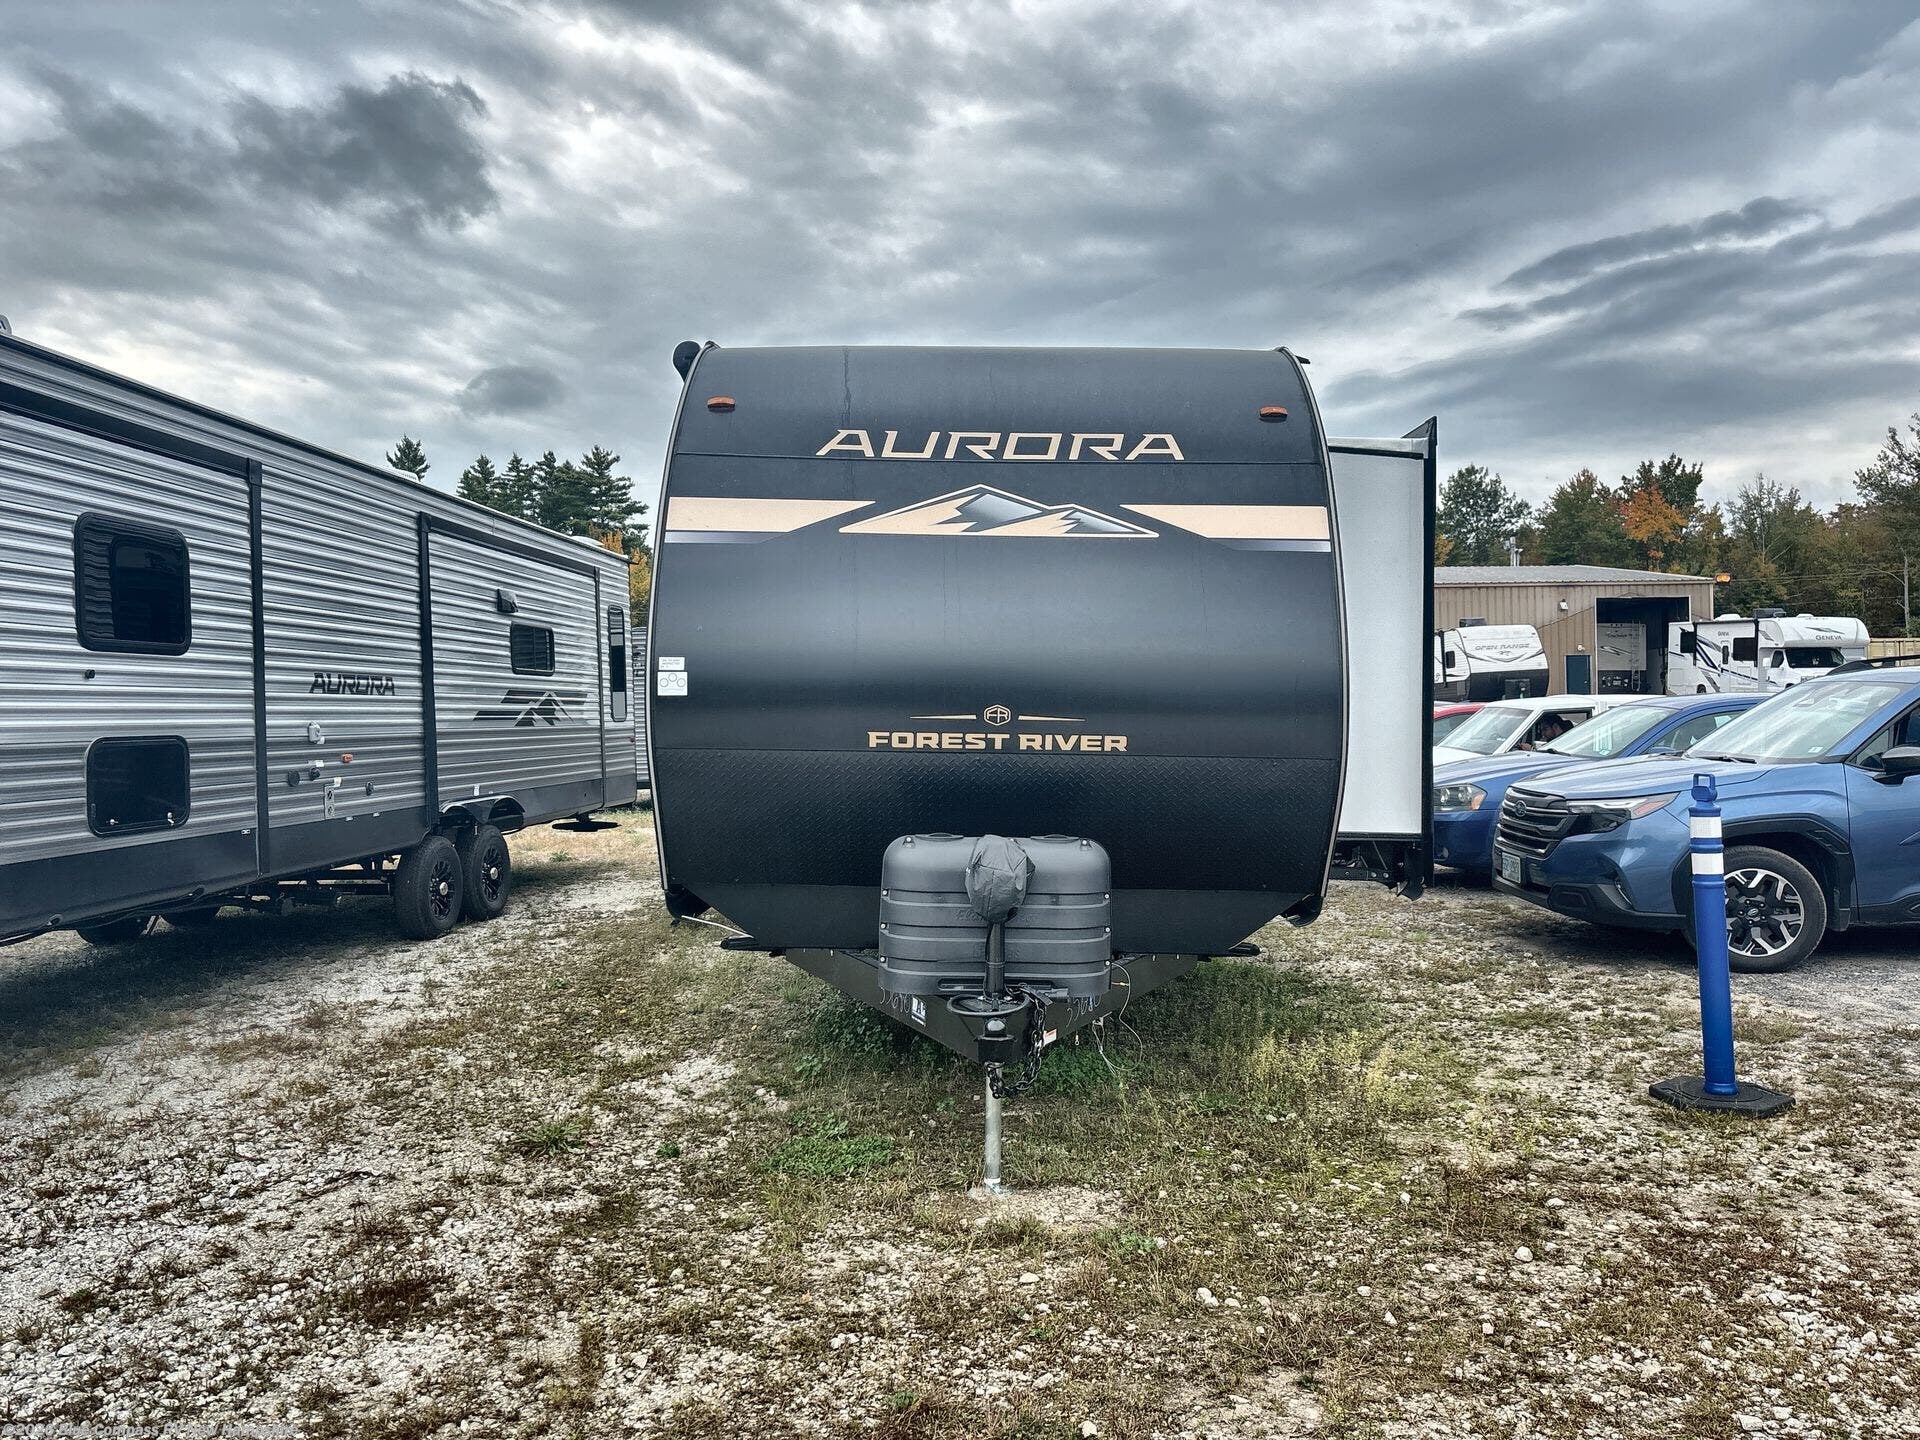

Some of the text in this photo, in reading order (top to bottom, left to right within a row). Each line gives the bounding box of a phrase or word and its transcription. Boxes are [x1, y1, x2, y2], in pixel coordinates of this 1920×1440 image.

[815, 429, 1185, 461] AURORA
[308, 672, 396, 696] AURORA
[867, 731, 1128, 752] FOREST RIVER
